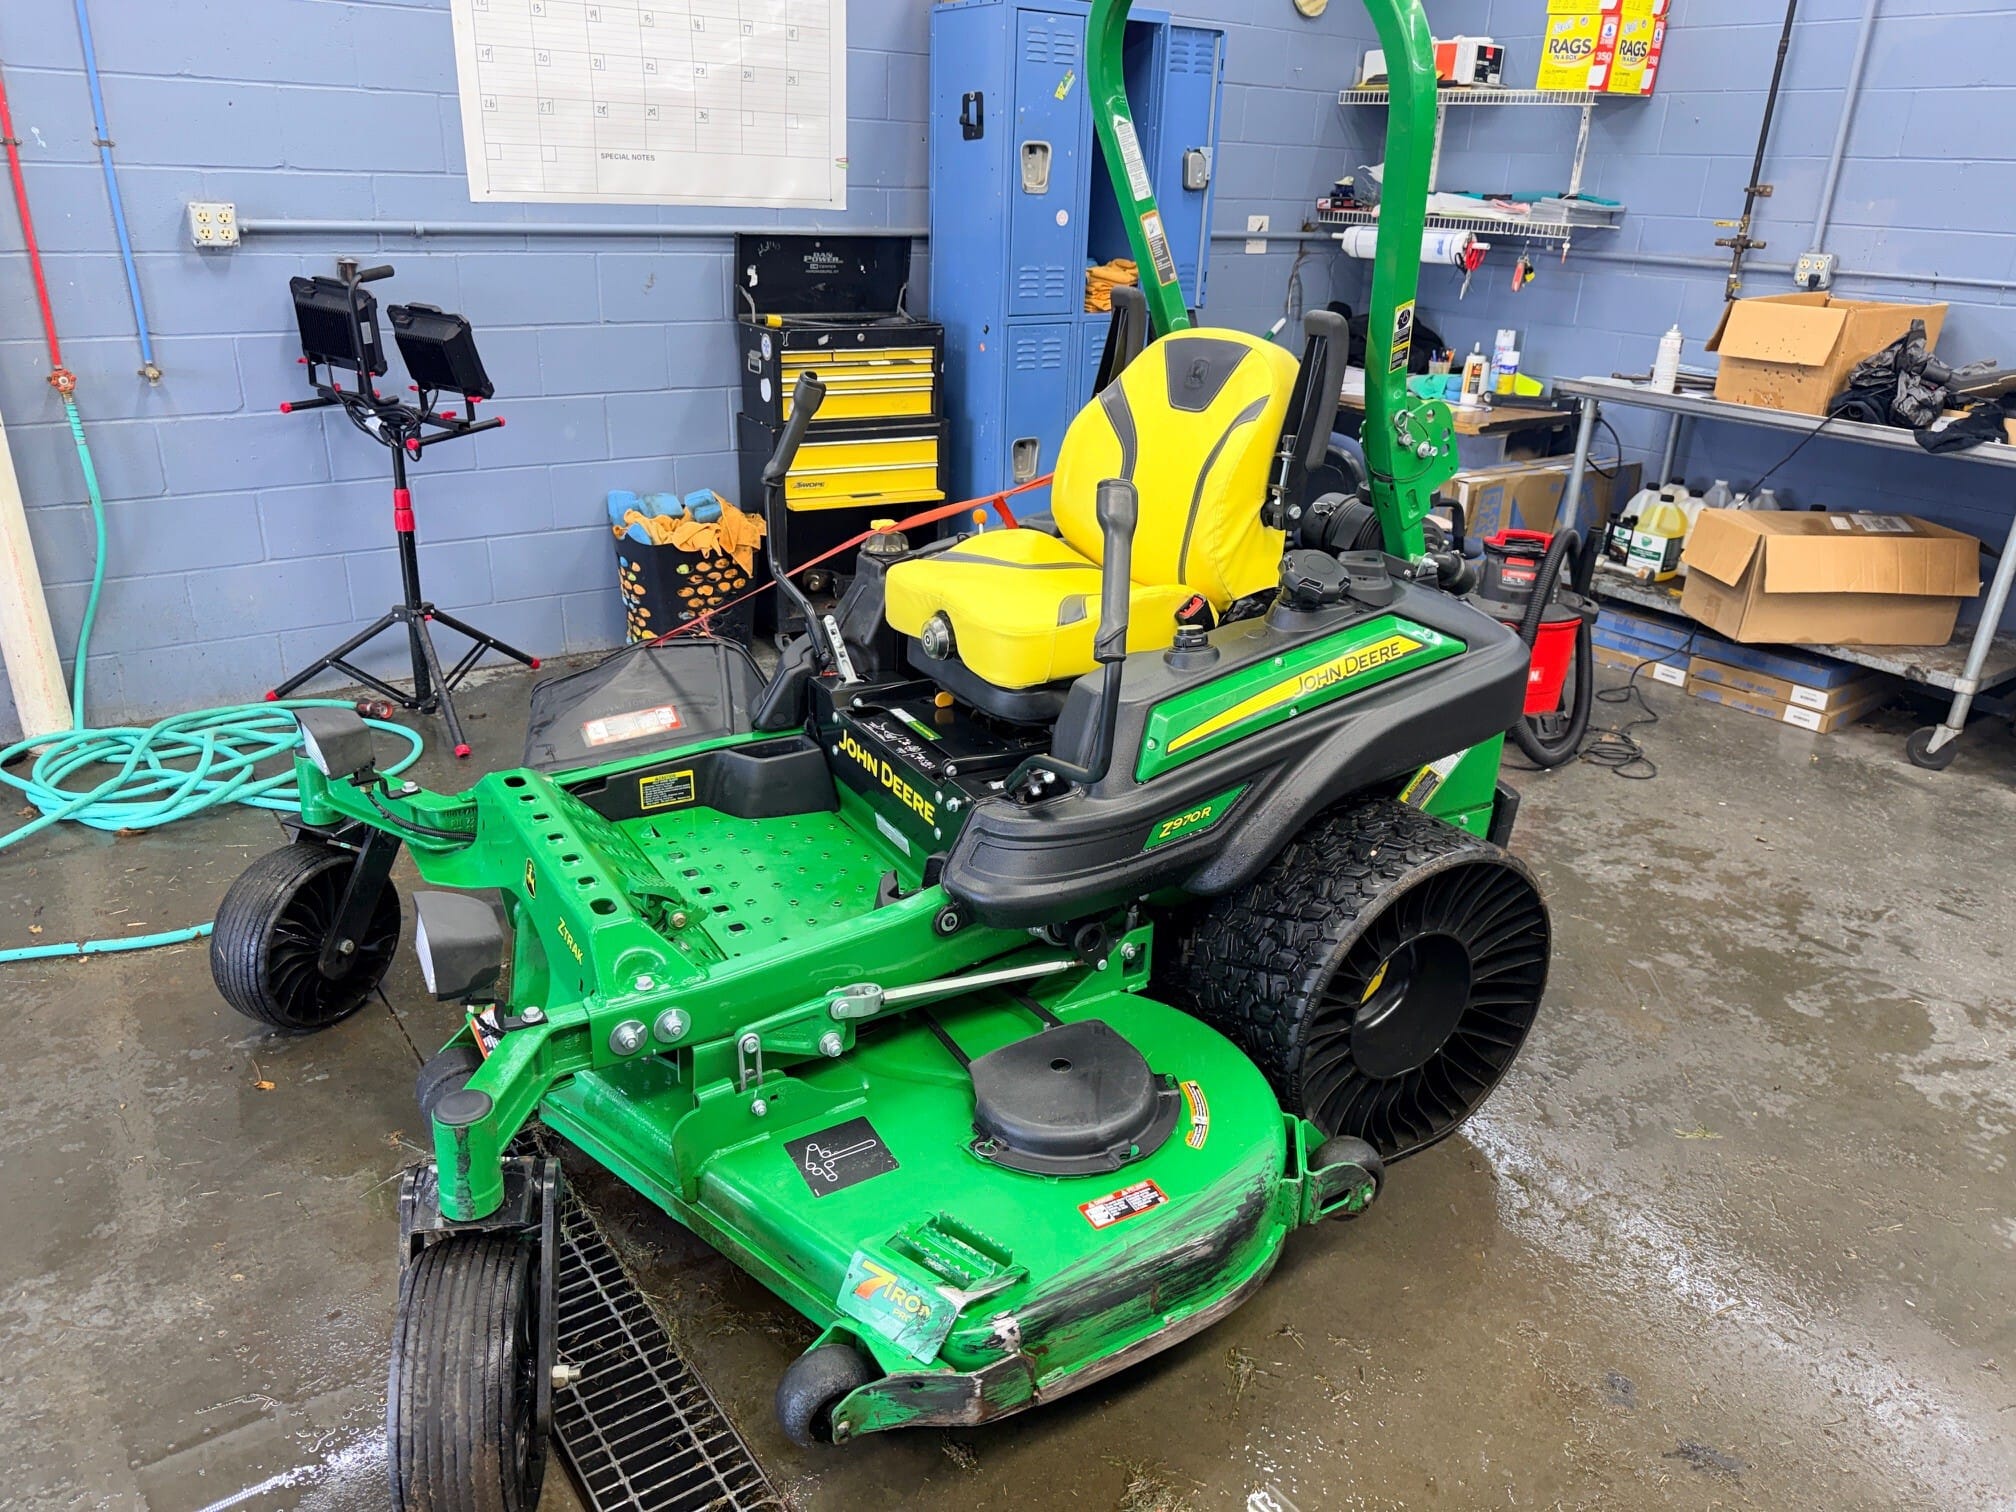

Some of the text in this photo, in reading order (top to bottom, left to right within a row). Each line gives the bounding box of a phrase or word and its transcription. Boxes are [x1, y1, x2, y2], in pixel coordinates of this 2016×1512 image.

[532, 3, 542, 13] 13
[589, 10, 597, 19] 14
[743, 24, 752, 34] 17
[1548, 38, 1592, 54] RAGS
[1619, 39, 1648, 57] RAGS
[481, 48, 490, 58] 19
[537, 53, 548, 63] 20
[1596, 52, 1612, 61] 350
[593, 58, 602, 68] 21
[695, 67, 705, 75] 23
[484, 99, 495, 109] 26
[540, 102, 551, 112] 27
[597, 105, 606, 115] 28
[698, 111, 707, 120] 30
[600, 152, 656, 162] SPECIAL NOTES
[1295, 641, 1401, 696] JOHN DEERE
[838, 729, 879, 778] JOHN
[881, 760, 936, 827] DEERE
[1158, 806, 1212, 838] Z970R
